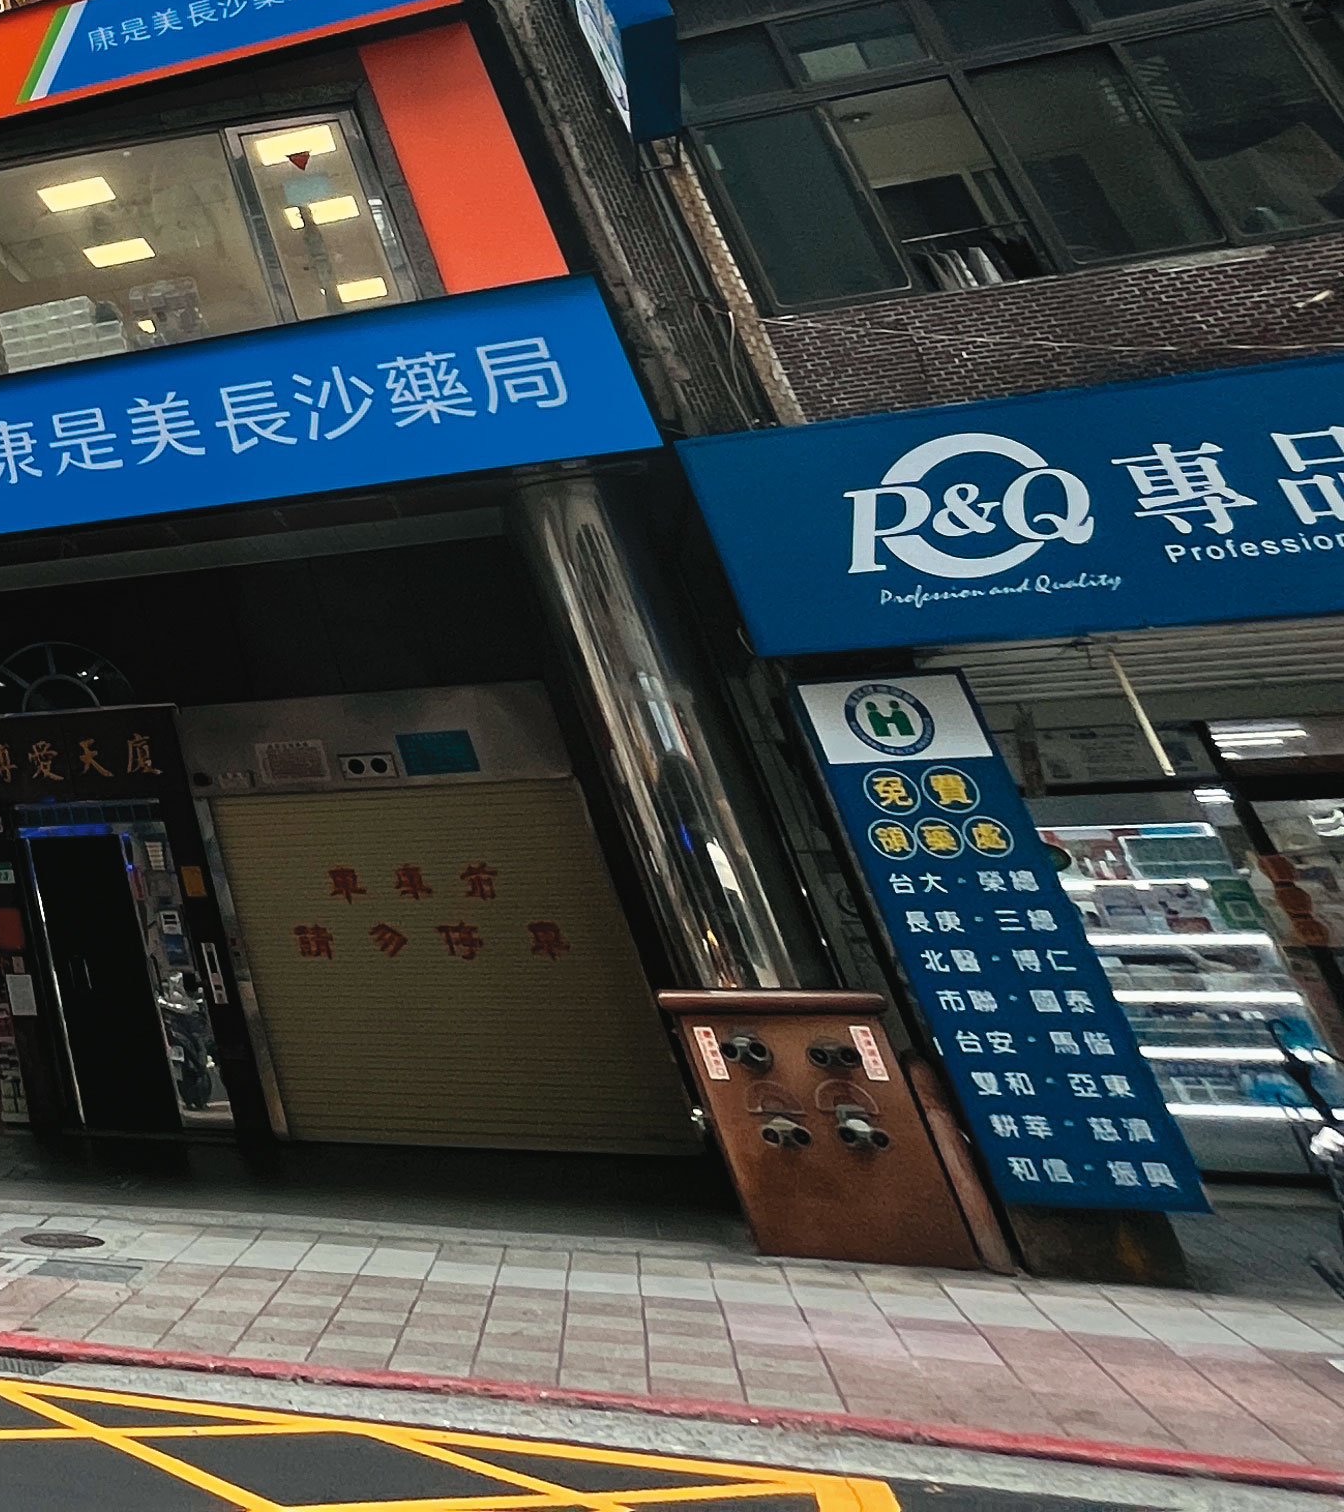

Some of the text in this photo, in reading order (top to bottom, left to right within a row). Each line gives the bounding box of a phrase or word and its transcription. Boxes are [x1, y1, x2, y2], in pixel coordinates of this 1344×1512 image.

[880, 573, 1122, 608] Profession and Quality
